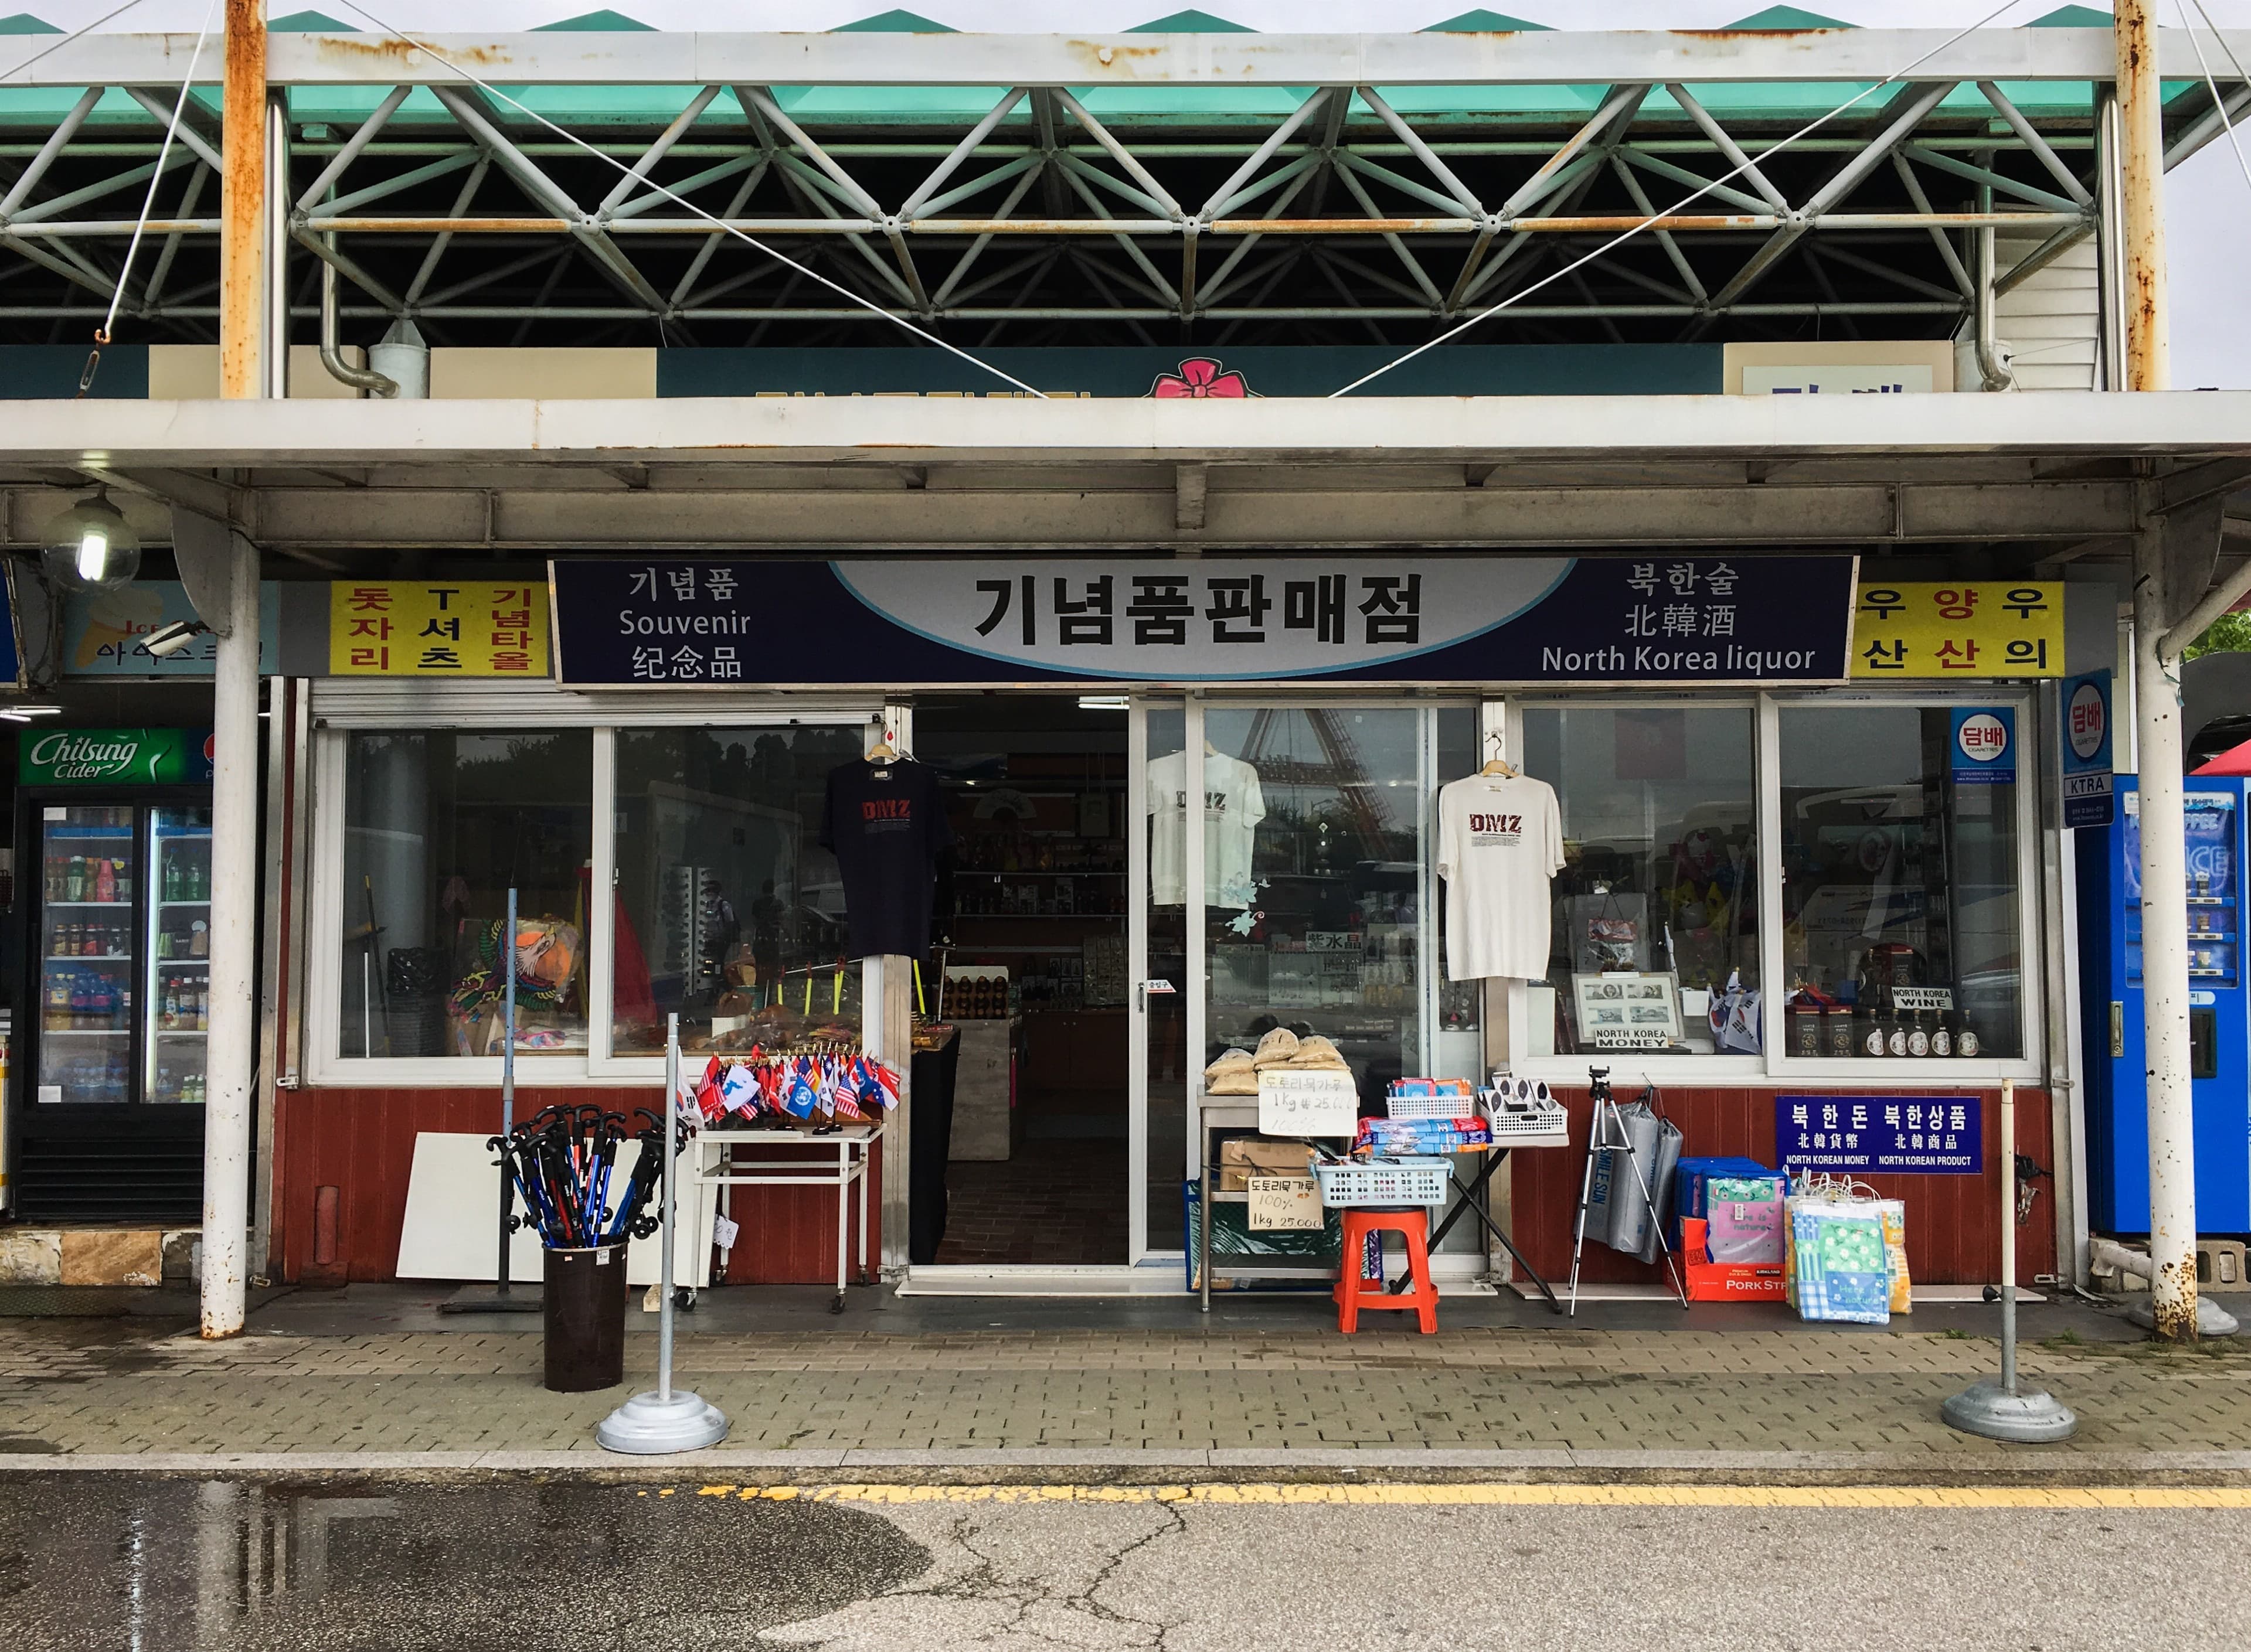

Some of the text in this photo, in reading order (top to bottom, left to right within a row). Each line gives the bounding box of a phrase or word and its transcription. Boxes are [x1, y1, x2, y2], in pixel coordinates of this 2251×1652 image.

[629, 567, 739, 602] 기념품
[1627, 562, 1739, 597] 북한술
[974, 573, 1422, 646] 기념품판매점
[619, 609, 751, 635] Souvenir
[1624, 603, 1737, 638] 北韓酒
[631, 645, 742, 679] 纪念品
[1542, 644, 1816, 676] North Korea liquor
[2072, 701, 2102, 734] 담배
[1963, 727, 2004, 747] 담배
[30, 733, 139, 775] Chilsung
[53, 762, 114, 779] Cider
[2070, 776, 2105, 794] KTRA
[862, 799, 910, 819] DMZ
[1469, 813, 1522, 833] DMZ
[1901, 999, 1946, 1007] WINE
[1923, 990, 1951, 998] KOREA
[1599, 1039, 1665, 1047] MONEY
[1634, 1030, 1667, 1038] KOREA
[1884, 1105, 1966, 1130] 북한상품
[1798, 1132, 1859, 1149] 北韓貨幣
[1895, 1133, 1957, 1150] 北韓商品
[1787, 1154, 1869, 1165] NORTH KOREAN MONEY
[1879, 1155, 1971, 1166] NORTH KOREAN PRODUCT
[1592, 1149, 1613, 1205] SMILE SUN
[1259, 1194, 1293, 1210] 100%
